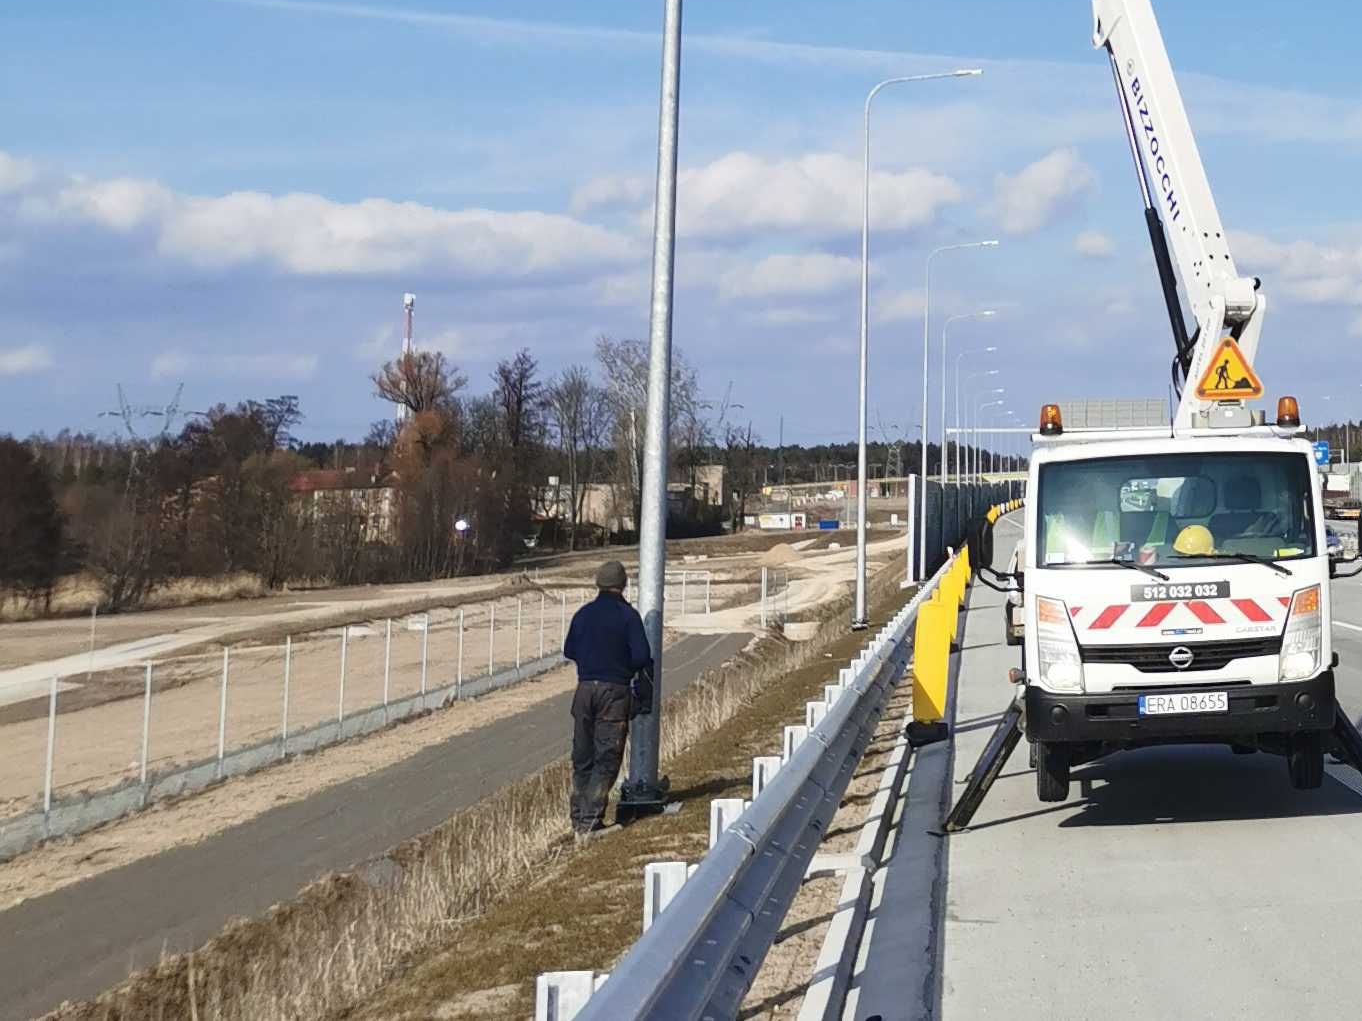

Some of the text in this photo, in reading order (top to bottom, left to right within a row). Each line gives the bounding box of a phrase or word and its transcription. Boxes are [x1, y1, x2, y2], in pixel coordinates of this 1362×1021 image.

[1132, 77, 1180, 221] BIZZOCCHI
[1143, 584, 1217, 598] 512 032 032
[1147, 694, 1225, 713] ERA 08655
